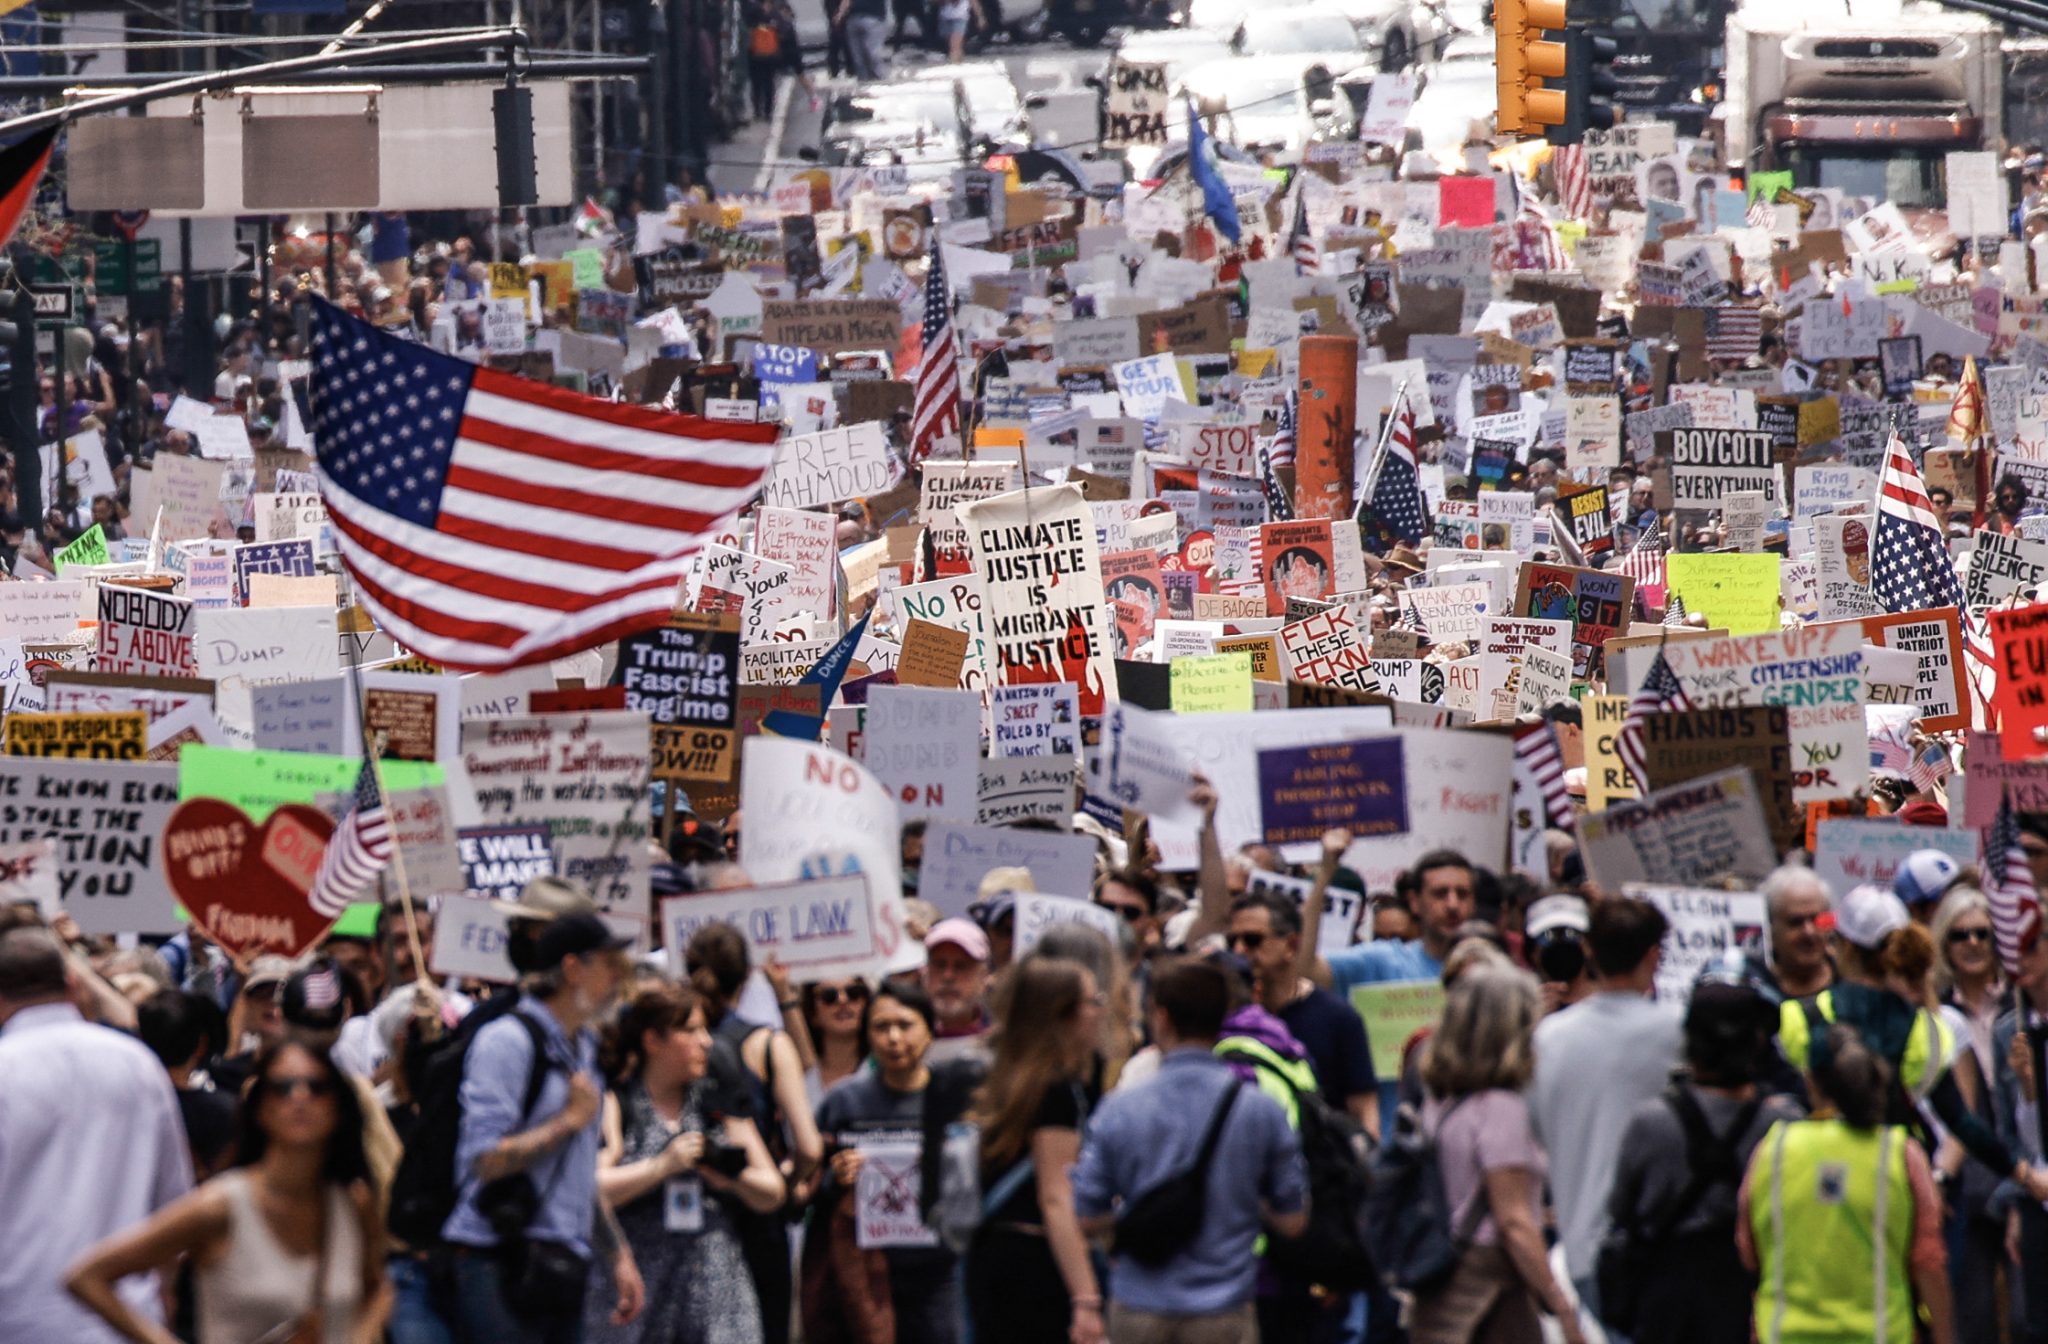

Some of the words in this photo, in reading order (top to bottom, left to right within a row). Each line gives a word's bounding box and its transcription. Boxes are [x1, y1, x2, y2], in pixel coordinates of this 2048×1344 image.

[755, 344, 811, 366] STOP
[763, 365, 794, 376] THE
[1123, 359, 1159, 379] GET
[1122, 377, 1177, 397] YOUR
[774, 428, 866, 478] FREE
[1675, 429, 1773, 466] BOYCOTT
[764, 462, 890, 508] MAHMOUD
[926, 477, 1007, 493] CLIMATE
[1675, 474, 1773, 500] EVERYTHING
[1811, 472, 1848, 486] Ring
[1571, 491, 1605, 516] RESIST
[803, 518, 827, 530] THE
[980, 518, 1081, 553] CLIMATE
[1575, 511, 1611, 543] EVIL
[57, 532, 99, 563] THINK
[762, 530, 831, 550] KLEPTOCRACY
[1978, 531, 2024, 561] WILL
[709, 553, 743, 574] HOW
[796, 551, 826, 562] BACK
[985, 549, 1086, 584] JUSTICE
[1969, 550, 2045, 586] SILENCE
[729, 567, 749, 584] IS
[745, 571, 789, 599] YOUR
[1161, 575, 1192, 587] FREE
[1579, 579, 1620, 594] WON'T
[1968, 570, 1993, 594] BE
[902, 591, 945, 618] NO
[1028, 585, 1048, 607] IS
[1408, 589, 1456, 606] THANK
[1460, 587, 1482, 603] YOU
[98, 586, 195, 633] NOBODY
[1290, 602, 1326, 616] STOP
[1420, 601, 1475, 618] SENATOR
[993, 605, 1096, 641] MIGRANT
[1281, 604, 1355, 650] FCK
[1492, 622, 1524, 636] DON'T
[1525, 624, 1557, 636] TREAD
[1897, 624, 1941, 640] UNPAID
[99, 624, 120, 656] IS
[128, 633, 194, 671] ABOVE
[660, 629, 695, 646] The
[996, 632, 1101, 668] JUSTICE
[1289, 630, 1356, 664] THESE
[1505, 635, 1523, 645] ON
[1897, 637, 1945, 652] PATRIOT
[32, 652, 74, 666] KINGS
[207, 640, 285, 666] DUMP
[631, 643, 726, 680] Trump
[817, 636, 854, 679] DUNCE
[1294, 643, 1370, 682] FCKN
[1693, 633, 1772, 670] WAKE
[1934, 654, 1948, 667] TO
[1450, 666, 1481, 691] ACT
[1525, 654, 1563, 683] AMERICA
[1750, 651, 1863, 686] CITIZENSHIP
[626, 666, 731, 701] Fascist
[995, 689, 1005, 701] A
[1042, 687, 1057, 699] OF
[1388, 684, 1399, 696] A
[1761, 678, 1859, 706] GENDER
[625, 692, 731, 726] Regime
[1004, 704, 1039, 721] SHEEP
[8, 717, 58, 740] FUND
[63, 715, 143, 739] PEOPLE'S
[996, 724, 1033, 740] RULED
[1035, 722, 1052, 738] BY
[691, 731, 729, 751] GO
[1802, 743, 1843, 765] YOU
[806, 752, 862, 795] NO
[1019, 767, 1078, 787] AGAINST
[37, 776, 113, 798] KNOW
[122, 779, 180, 805] ELON
[522, 776, 547, 800] the
[4, 805, 79, 829] STOLE
[92, 807, 143, 831] THE
[480, 833, 550, 863] WILL
[60, 870, 134, 899] YOU
[750, 904, 779, 943] OF
[793, 899, 855, 939] LAW
